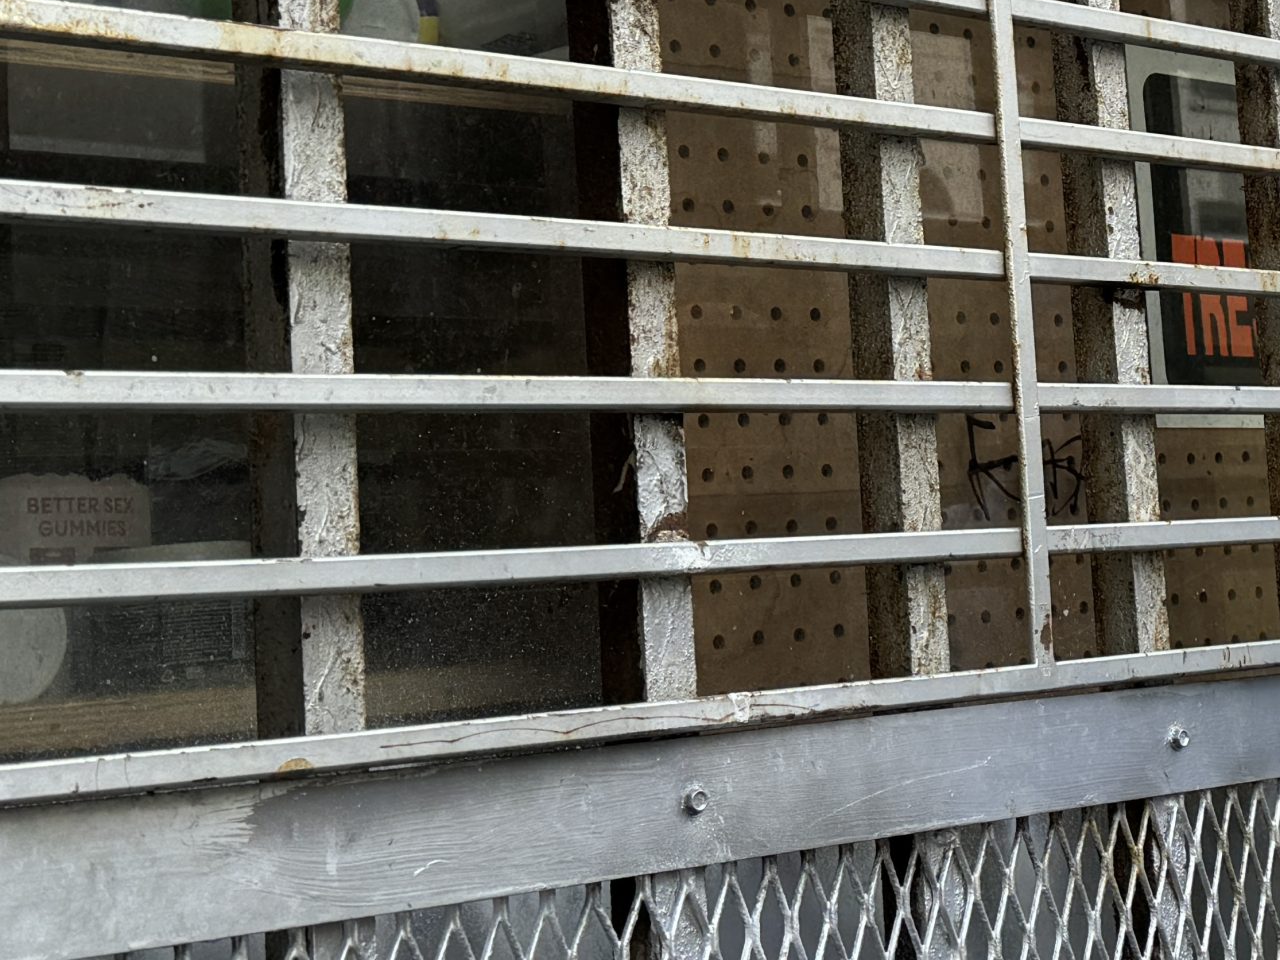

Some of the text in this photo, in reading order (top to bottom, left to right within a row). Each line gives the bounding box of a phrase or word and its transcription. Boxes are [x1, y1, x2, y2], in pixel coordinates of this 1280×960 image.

[26, 496, 135, 514] BETTER SEX
[38, 519, 127, 538] GUMMIES
